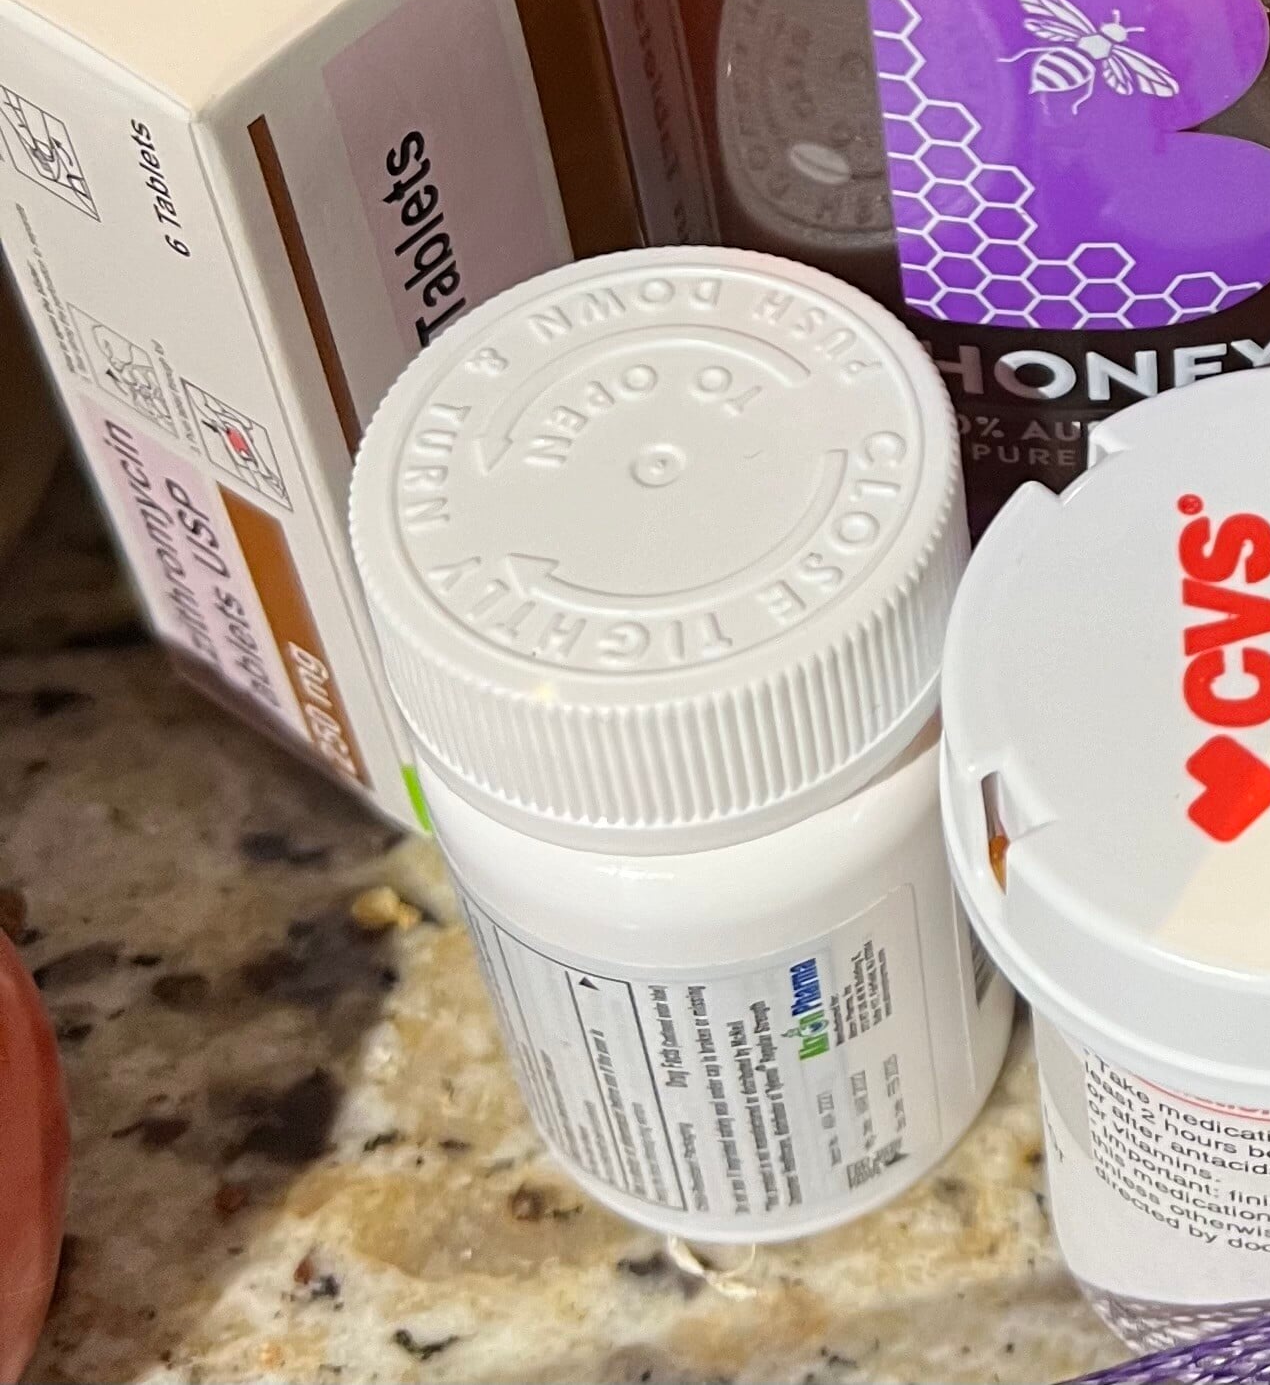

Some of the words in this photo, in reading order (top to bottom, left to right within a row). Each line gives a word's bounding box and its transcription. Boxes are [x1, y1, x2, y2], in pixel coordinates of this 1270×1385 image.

[130, 119, 184, 231] Tablets
[168, 233, 192, 259] 6
[382, 129, 467, 346] Tablets
[528, 275, 724, 343] DOWN
[753, 289, 882, 384] PUSH
[465, 347, 509, 377] &
[692, 364, 766, 415] TO
[523, 362, 660, 469] OPEN
[404, 401, 472, 535] TURN
[971, 442, 1077, 466] PURE
[165, 477, 231, 579] USP
[757, 430, 909, 622] CLOSE
[427, 554, 736, 662] TIGHTLY
[286, 640, 333, 708] mg
[789, 958, 824, 1017] Pharma
[1085, 1061, 1135, 1112] least
[1141, 1108, 1156, 1125] 2
[1164, 1117, 1238, 1154] hours
[1095, 1057, 1150, 1105] Take
[1091, 1130, 1126, 1168] this
[1112, 1105, 1163, 1143] after
[1112, 1120, 1222, 1183] vitamins.
[1093, 1148, 1161, 1205] unless
[1102, 1125, 1220, 1198] Important:
[1095, 1165, 1180, 1230] directed
[1188, 1224, 1217, 1245] by
